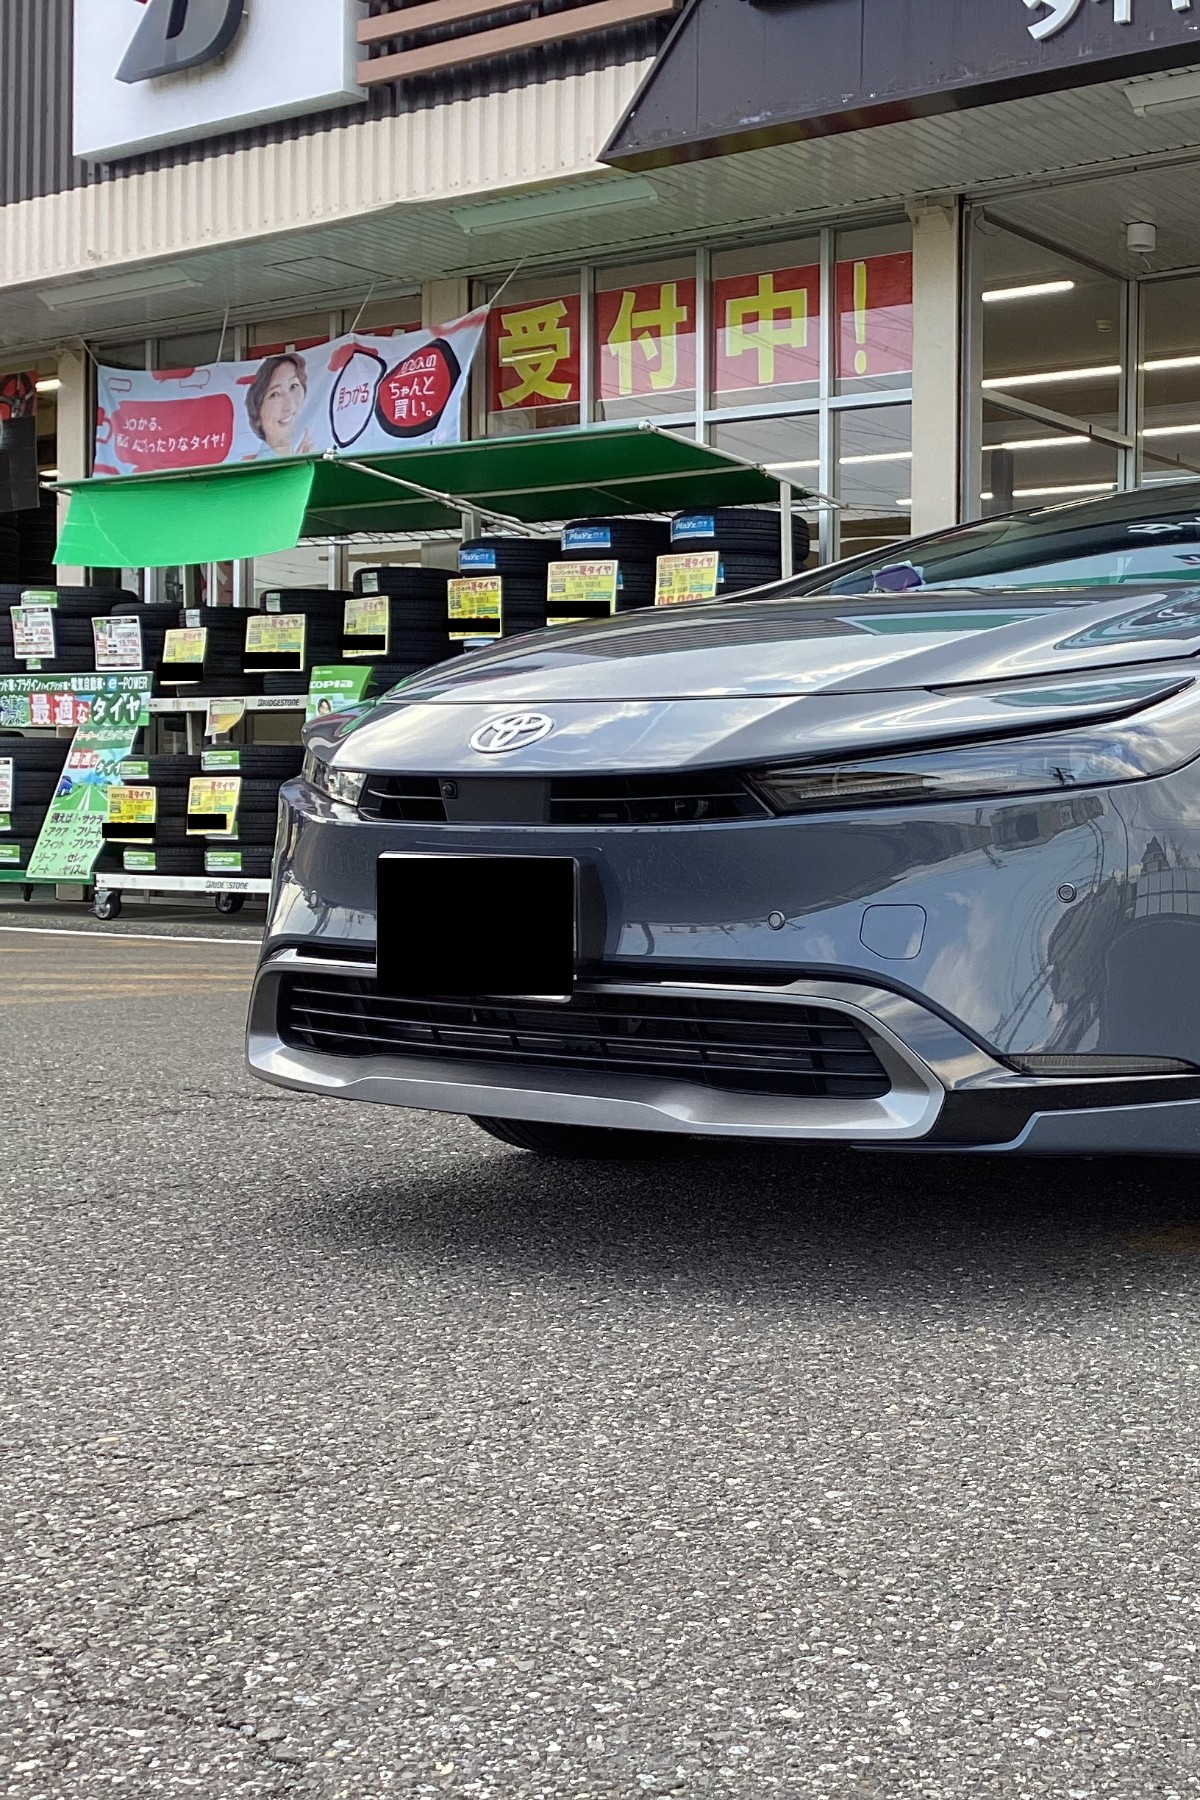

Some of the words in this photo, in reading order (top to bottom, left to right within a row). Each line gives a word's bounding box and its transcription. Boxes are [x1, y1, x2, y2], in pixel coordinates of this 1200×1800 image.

[388, 376, 434, 399] ちゃんと
[394, 398, 433, 419] 買い。
[579, 565, 611, 576] 夏タイヤ
[257, 698, 300, 707] BRIDGESTONE
